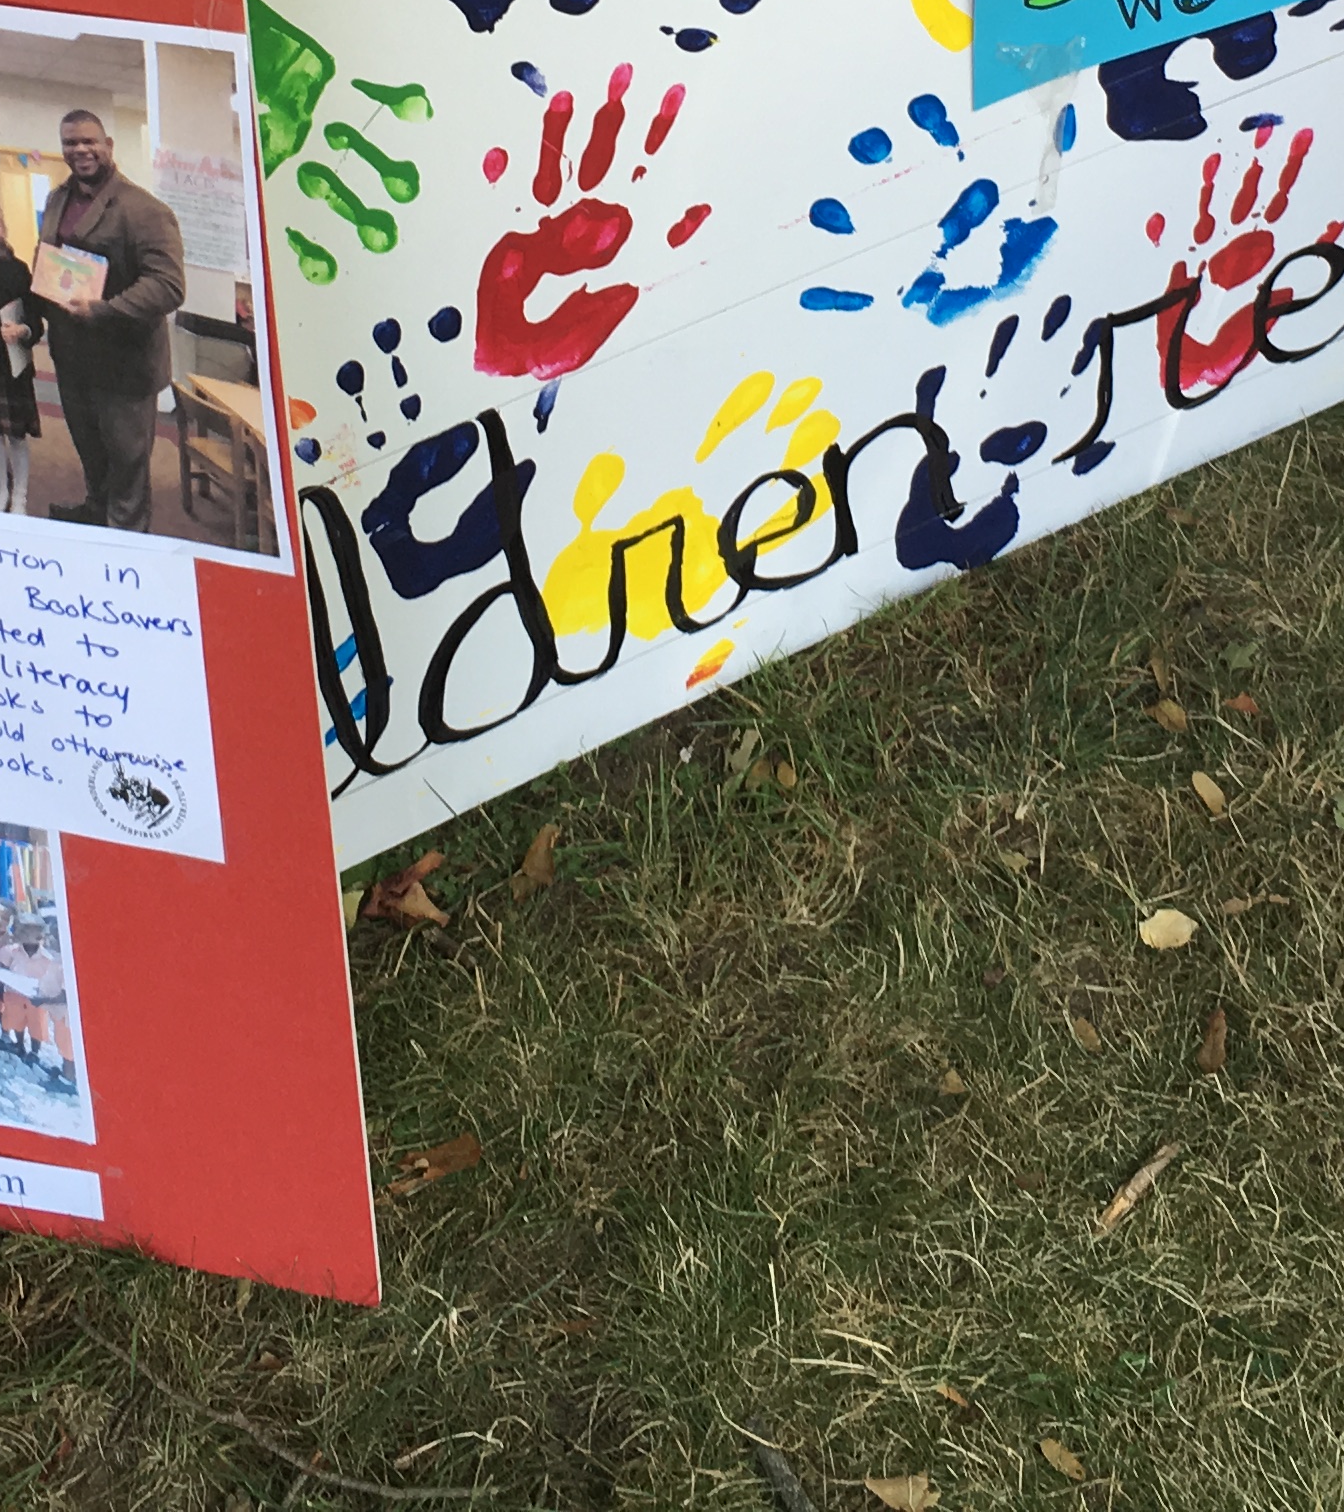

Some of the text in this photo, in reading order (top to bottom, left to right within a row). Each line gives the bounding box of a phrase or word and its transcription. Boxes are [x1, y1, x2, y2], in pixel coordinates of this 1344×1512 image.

[105, 560, 141, 589] in
[299, 408, 964, 799] ldren
[77, 630, 119, 659] to
[1, 655, 130, 712] literacy
[75, 704, 111, 728] to
[52, 734, 187, 773] otherwise
